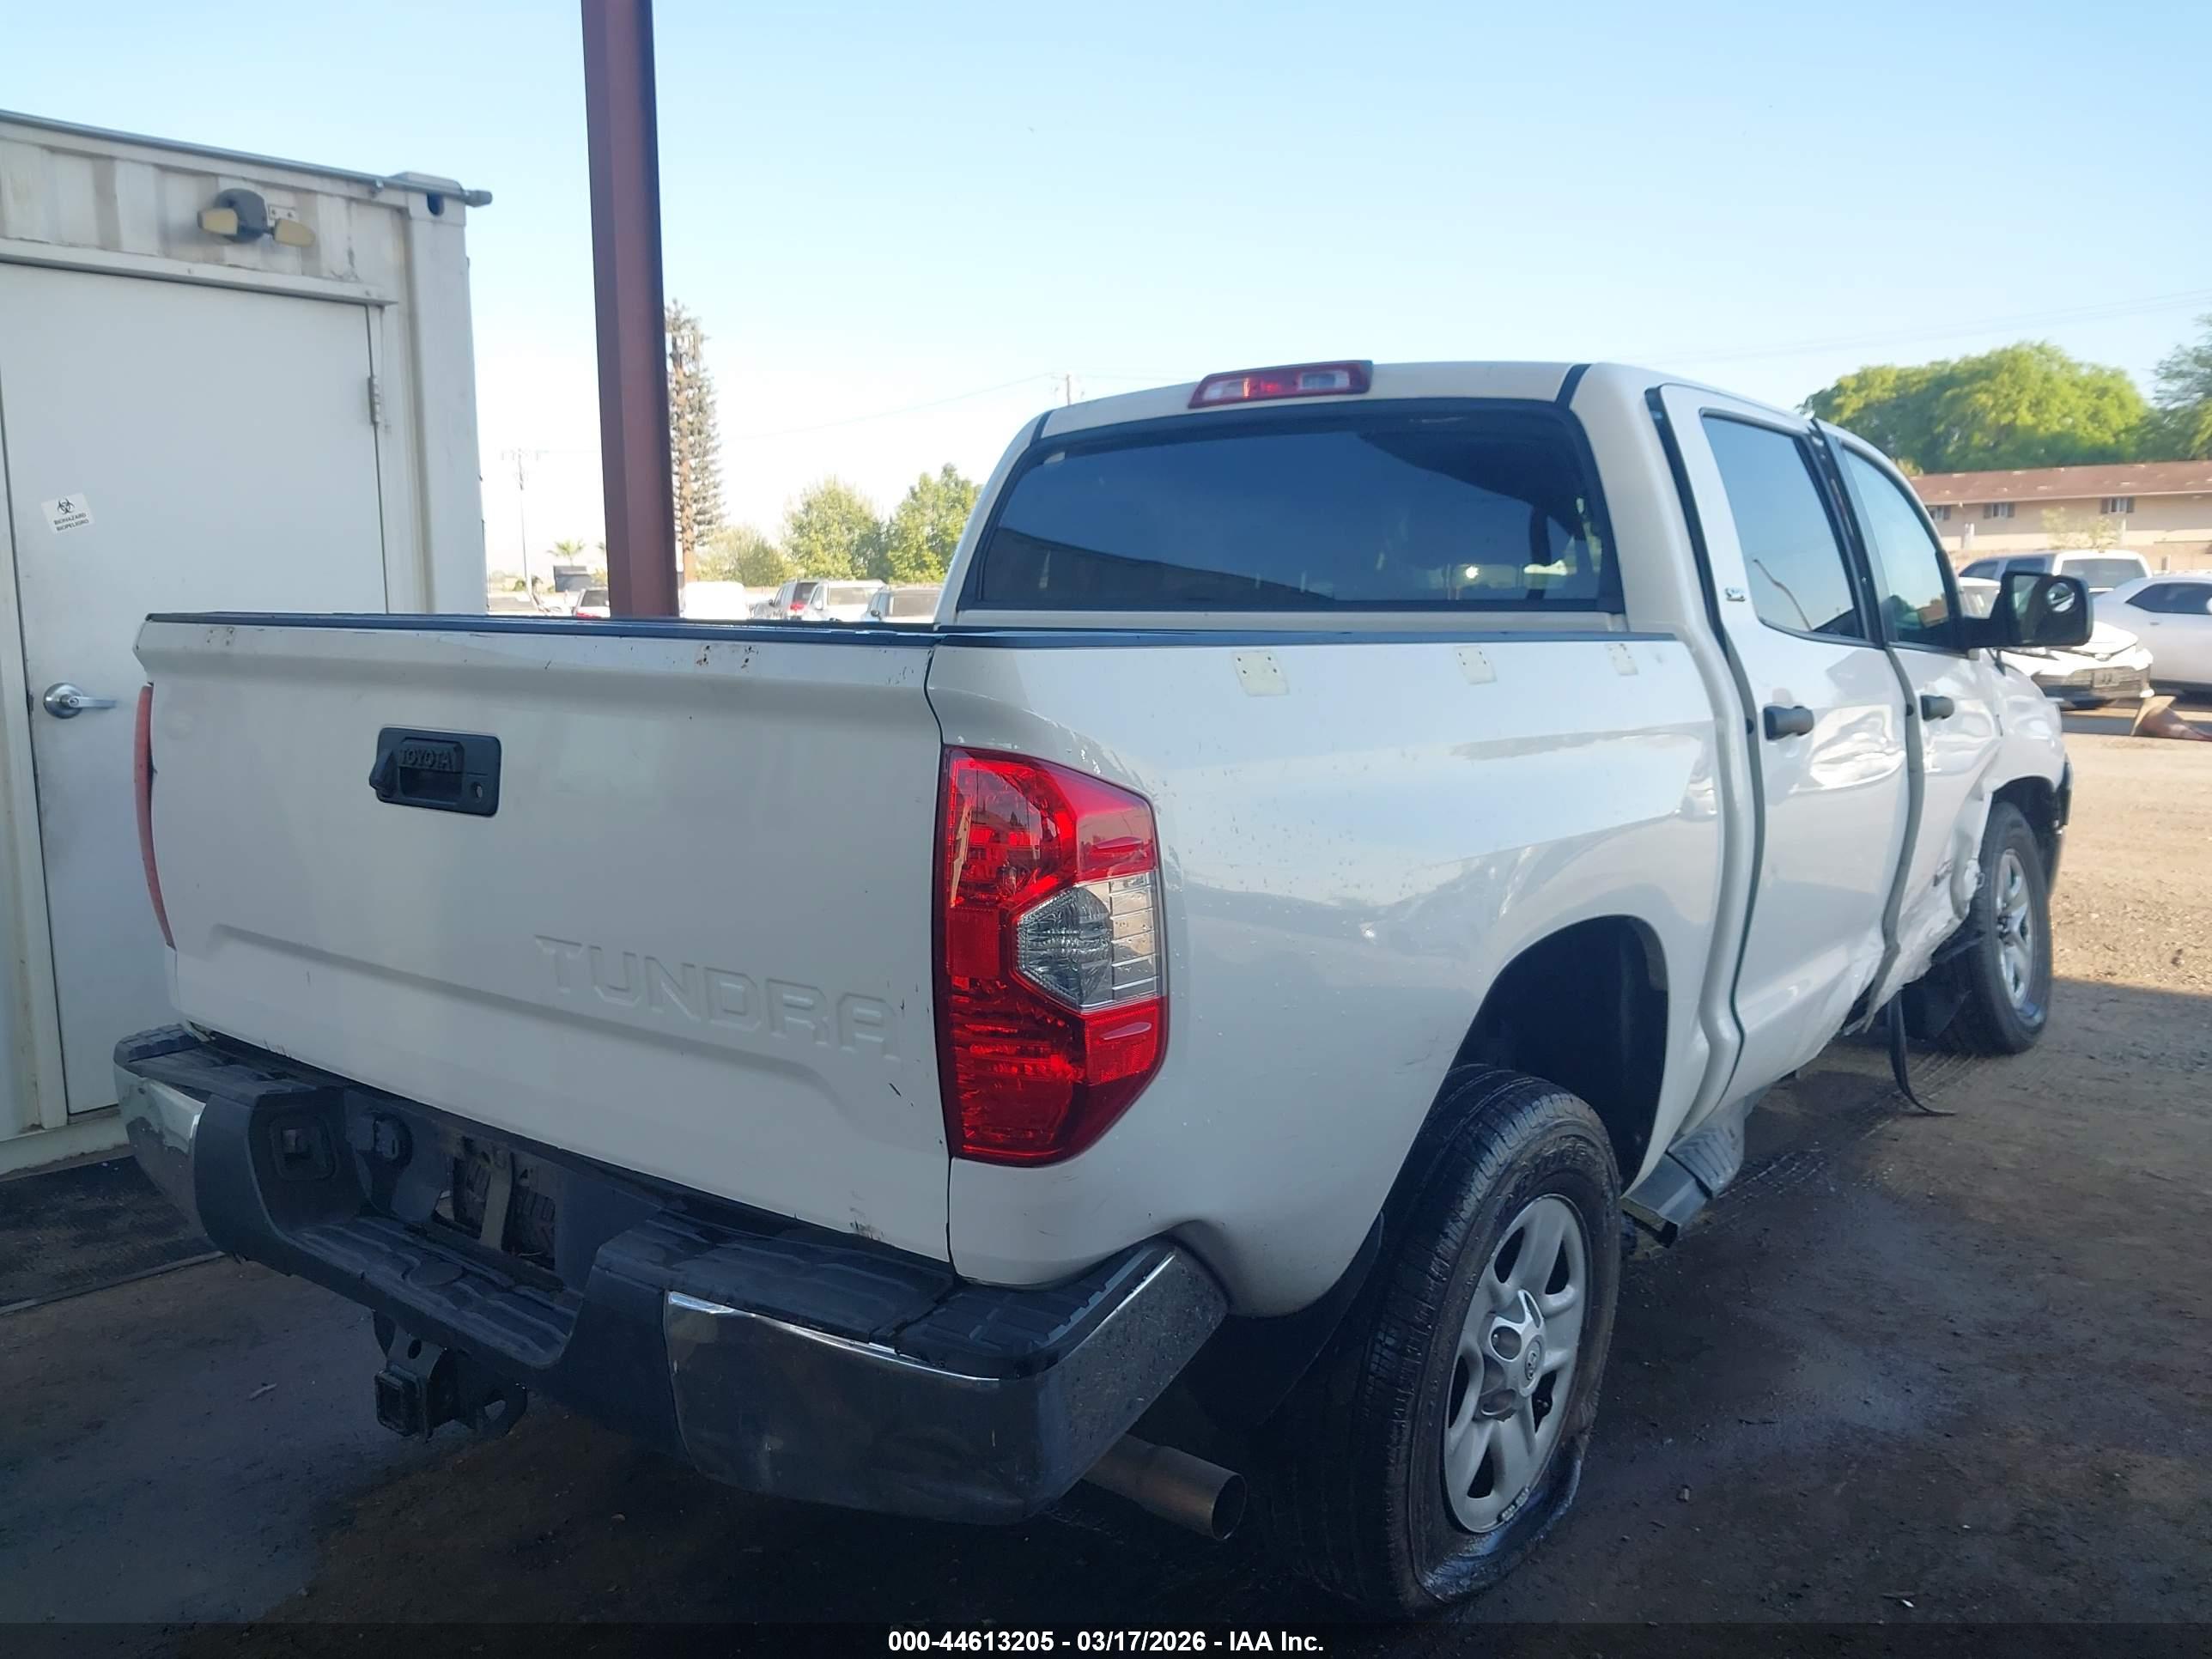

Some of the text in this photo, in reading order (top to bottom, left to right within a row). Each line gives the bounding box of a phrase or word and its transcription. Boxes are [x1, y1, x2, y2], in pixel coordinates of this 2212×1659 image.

[54, 513, 87, 526] BIOHAZARD
[399, 747, 455, 770] TOYOTA
[533, 934, 901, 1060] TUNDRA
